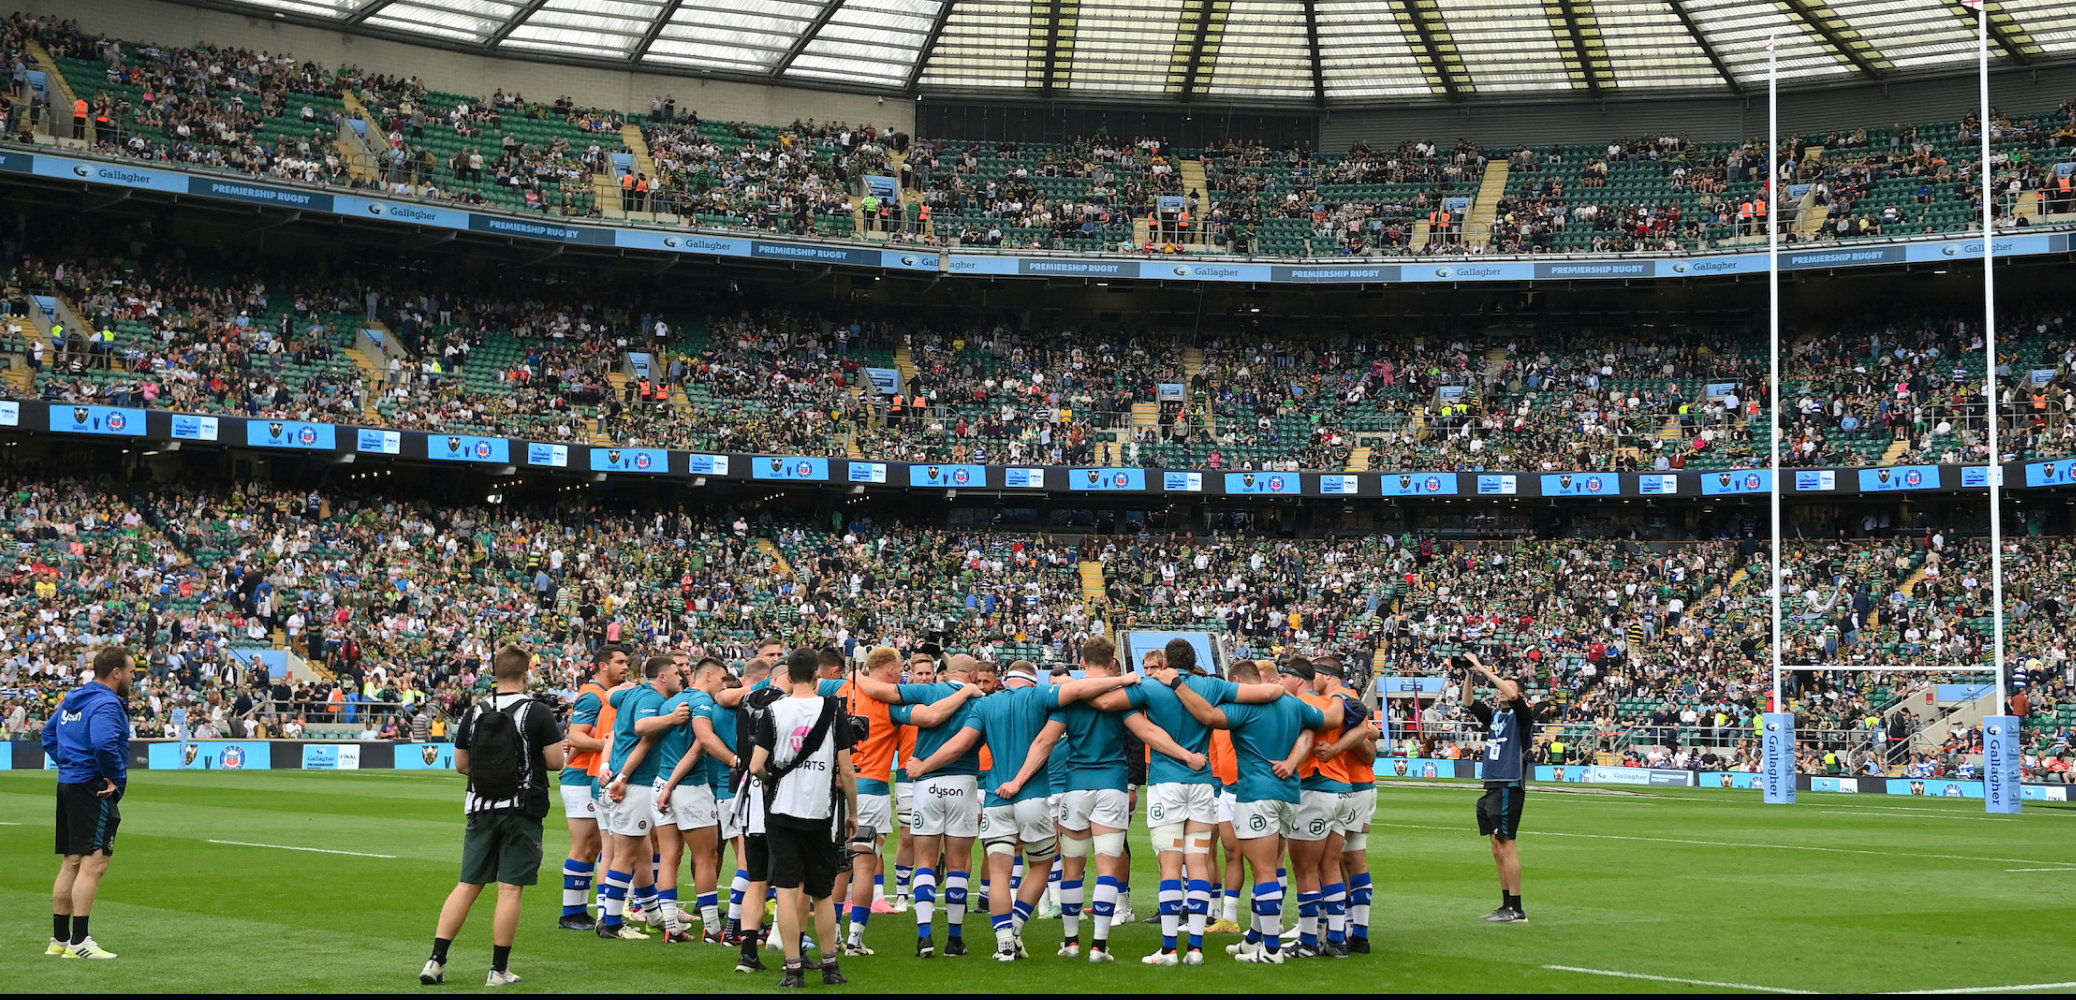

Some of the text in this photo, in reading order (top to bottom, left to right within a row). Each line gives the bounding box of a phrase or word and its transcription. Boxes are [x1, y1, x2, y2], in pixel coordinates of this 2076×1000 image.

[99, 168, 151, 183] Gallagher
[212, 183, 310, 204] PREMIERSHIP RUGBY
[390, 208, 436, 221] Gallagher
[490, 220, 578, 238] PREMIERSHIP RUGBY
[686, 239, 731, 251] Gallagher
[1964, 243, 2013, 254] Gallgher
[759, 245, 847, 259] PREMIERSHIP RUGBY
[1792, 251, 1883, 264] PREMIERSHIP RUGBY
[1029, 263, 1119, 273] PREMIERSHIP RUGBY
[1551, 264, 1643, 274] PREMIERSHIP RUGBY
[1693, 261, 1737, 271] Gallagher
[1194, 267, 1239, 278] Gallagher
[1292, 269, 1380, 278] PREMIERSHIP RUGBY
[1457, 268, 1501, 277] Gallagher
[307, 755, 334, 763] Gallagher
[1768, 735, 1779, 797] Gallagher
[1613, 772, 1647, 780] Gallagher
[1990, 739, 2001, 806] Gallagher
[928, 783, 964, 799] dyson
